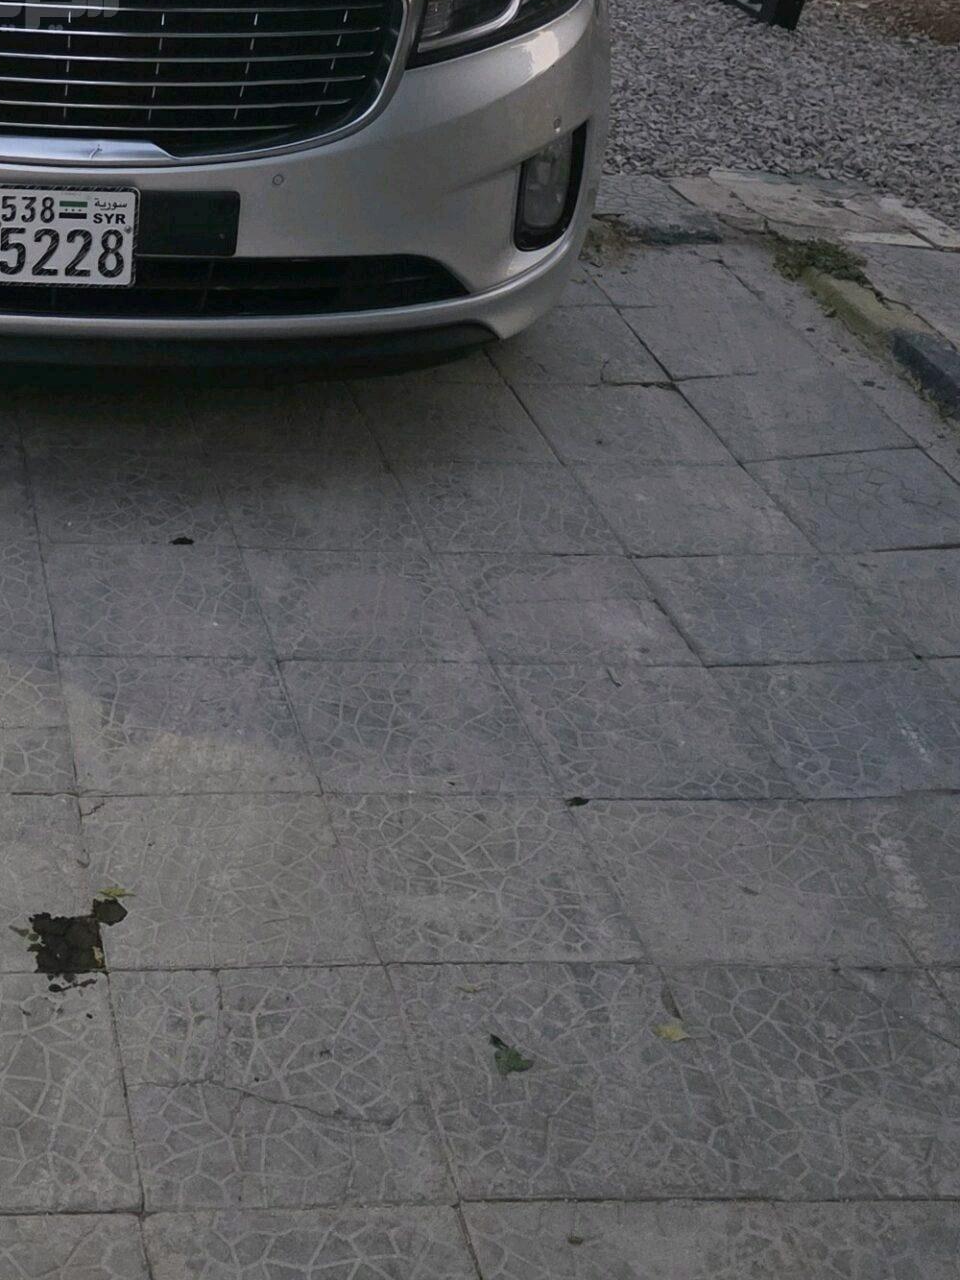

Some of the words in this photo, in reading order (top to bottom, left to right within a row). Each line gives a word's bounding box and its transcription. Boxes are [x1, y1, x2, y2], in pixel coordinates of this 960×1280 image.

[1, 195, 56, 224] 538
[93, 197, 128, 211] سورية
[92, 212, 126, 225] SYR
